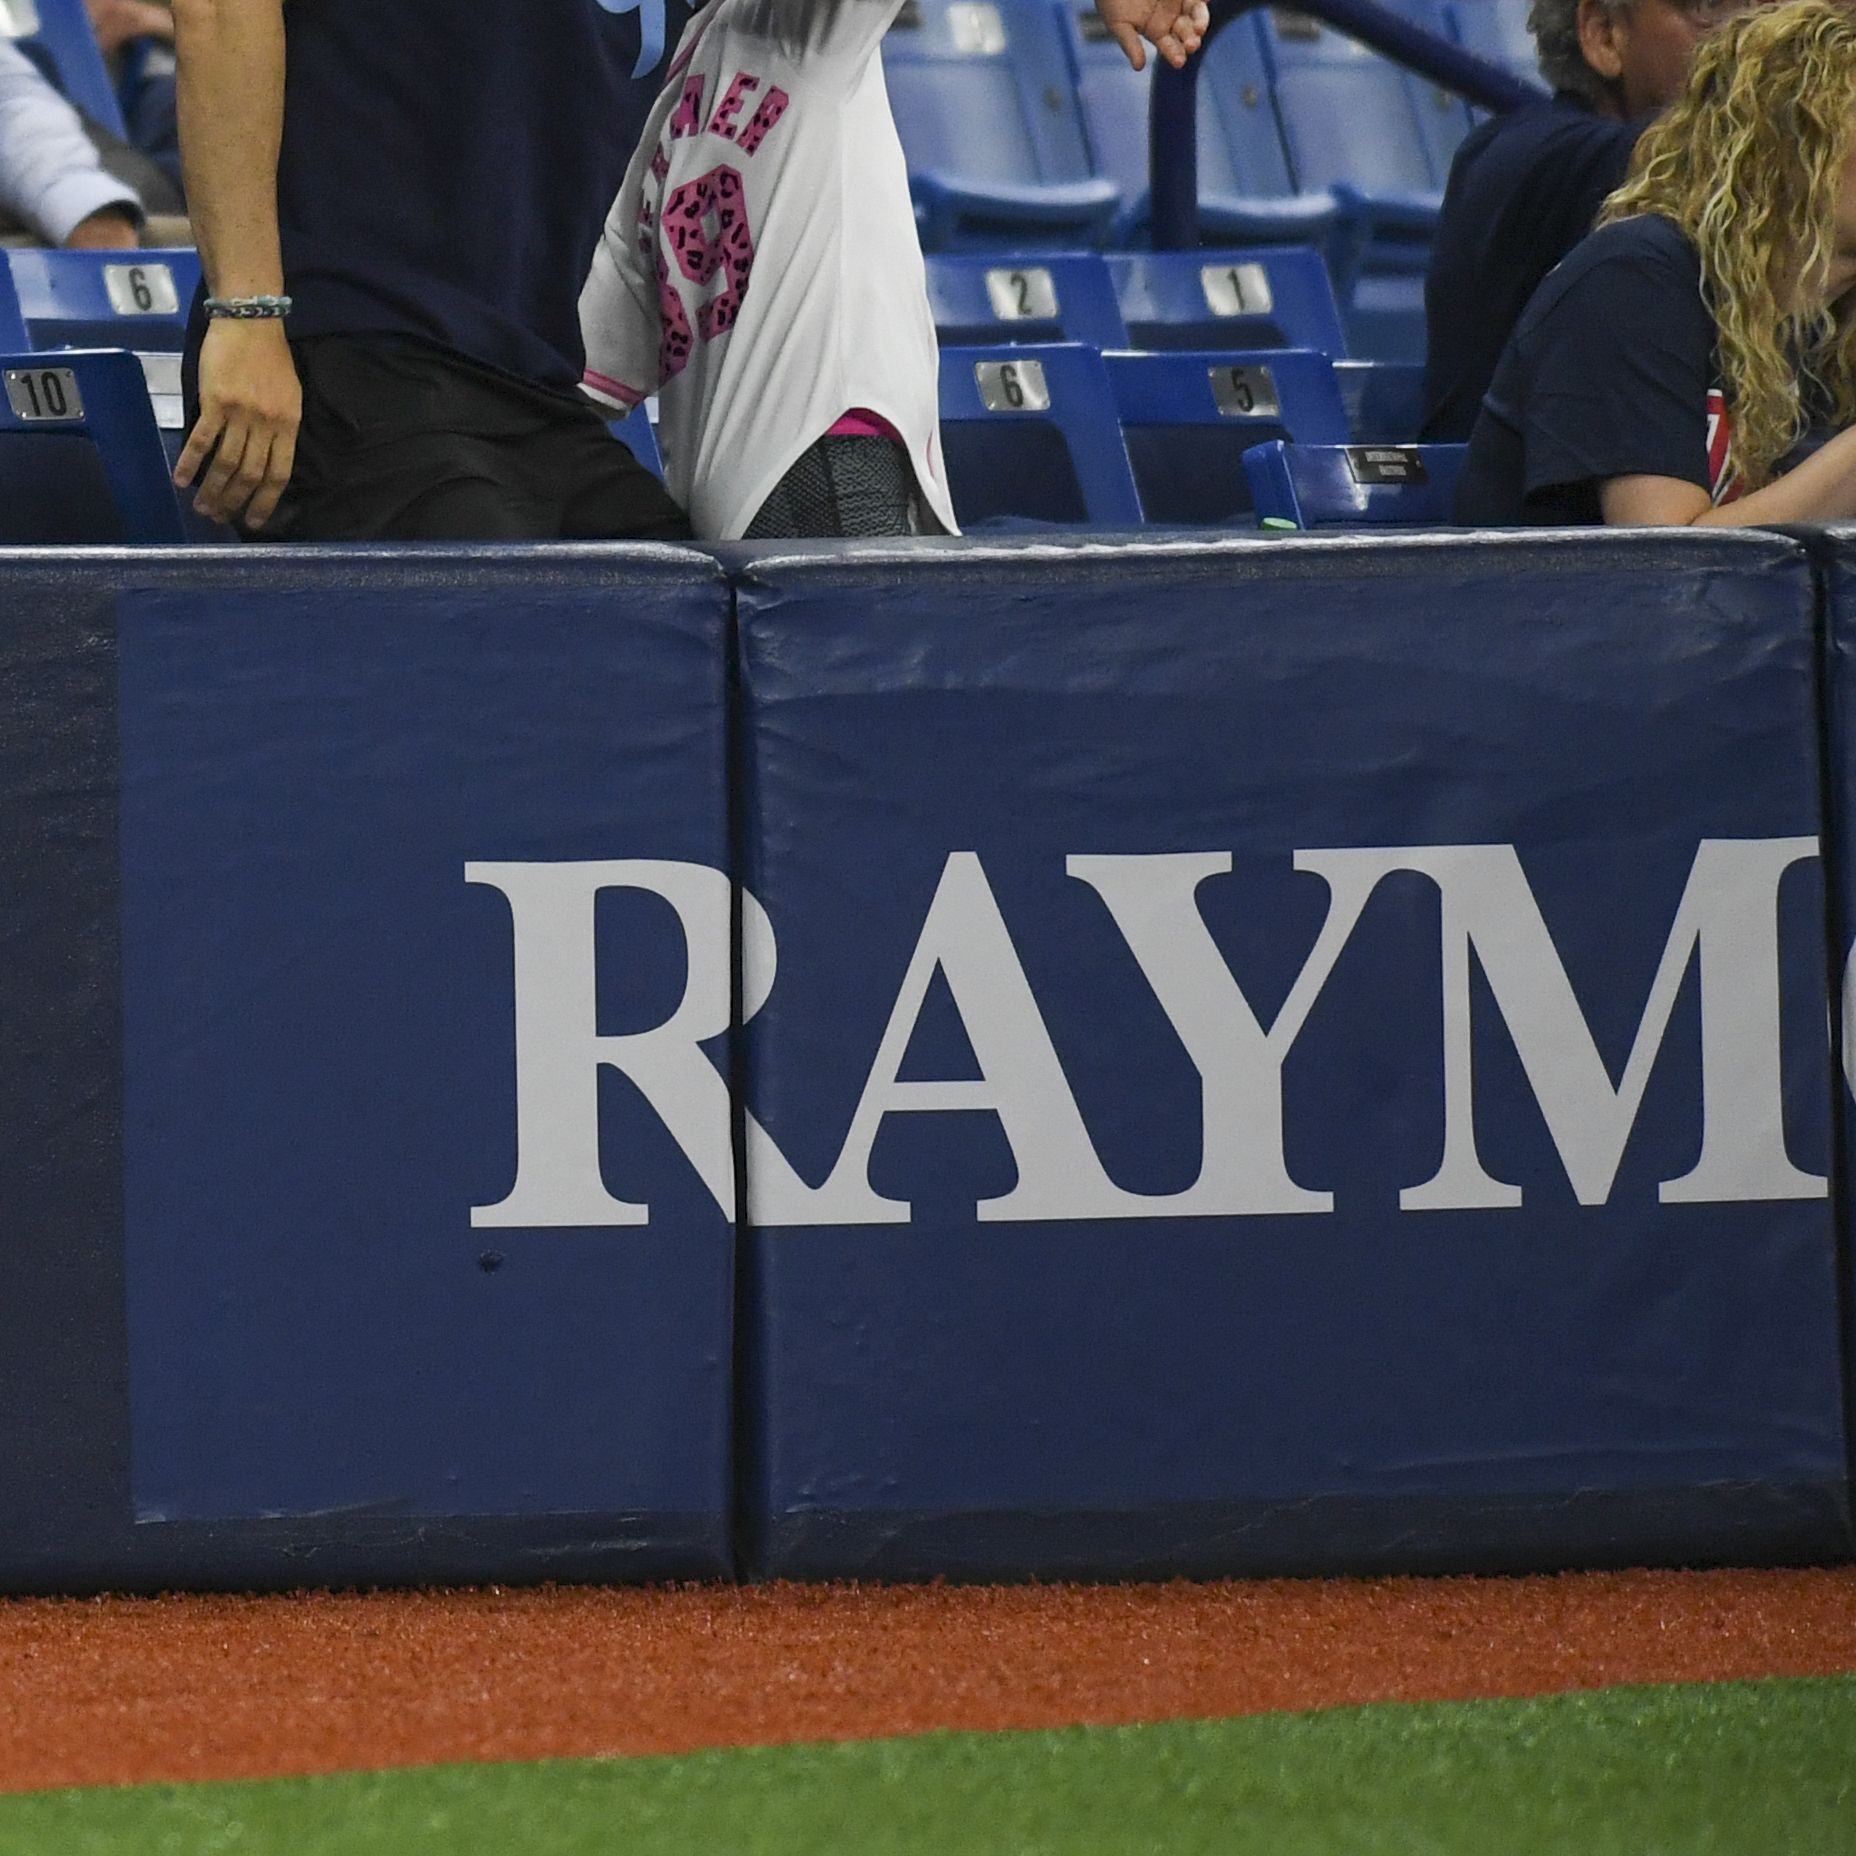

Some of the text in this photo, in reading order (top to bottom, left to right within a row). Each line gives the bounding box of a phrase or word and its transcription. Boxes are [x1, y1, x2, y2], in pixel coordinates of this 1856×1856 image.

[129, 269, 153, 312] 6
[1008, 273, 1034, 316] 2
[1225, 268, 1246, 312] 1
[20, 372, 68, 417] 10
[999, 364, 1025, 408] 6
[1231, 366, 1255, 413] 5
[464, 836, 1856, 1228] RAYM
